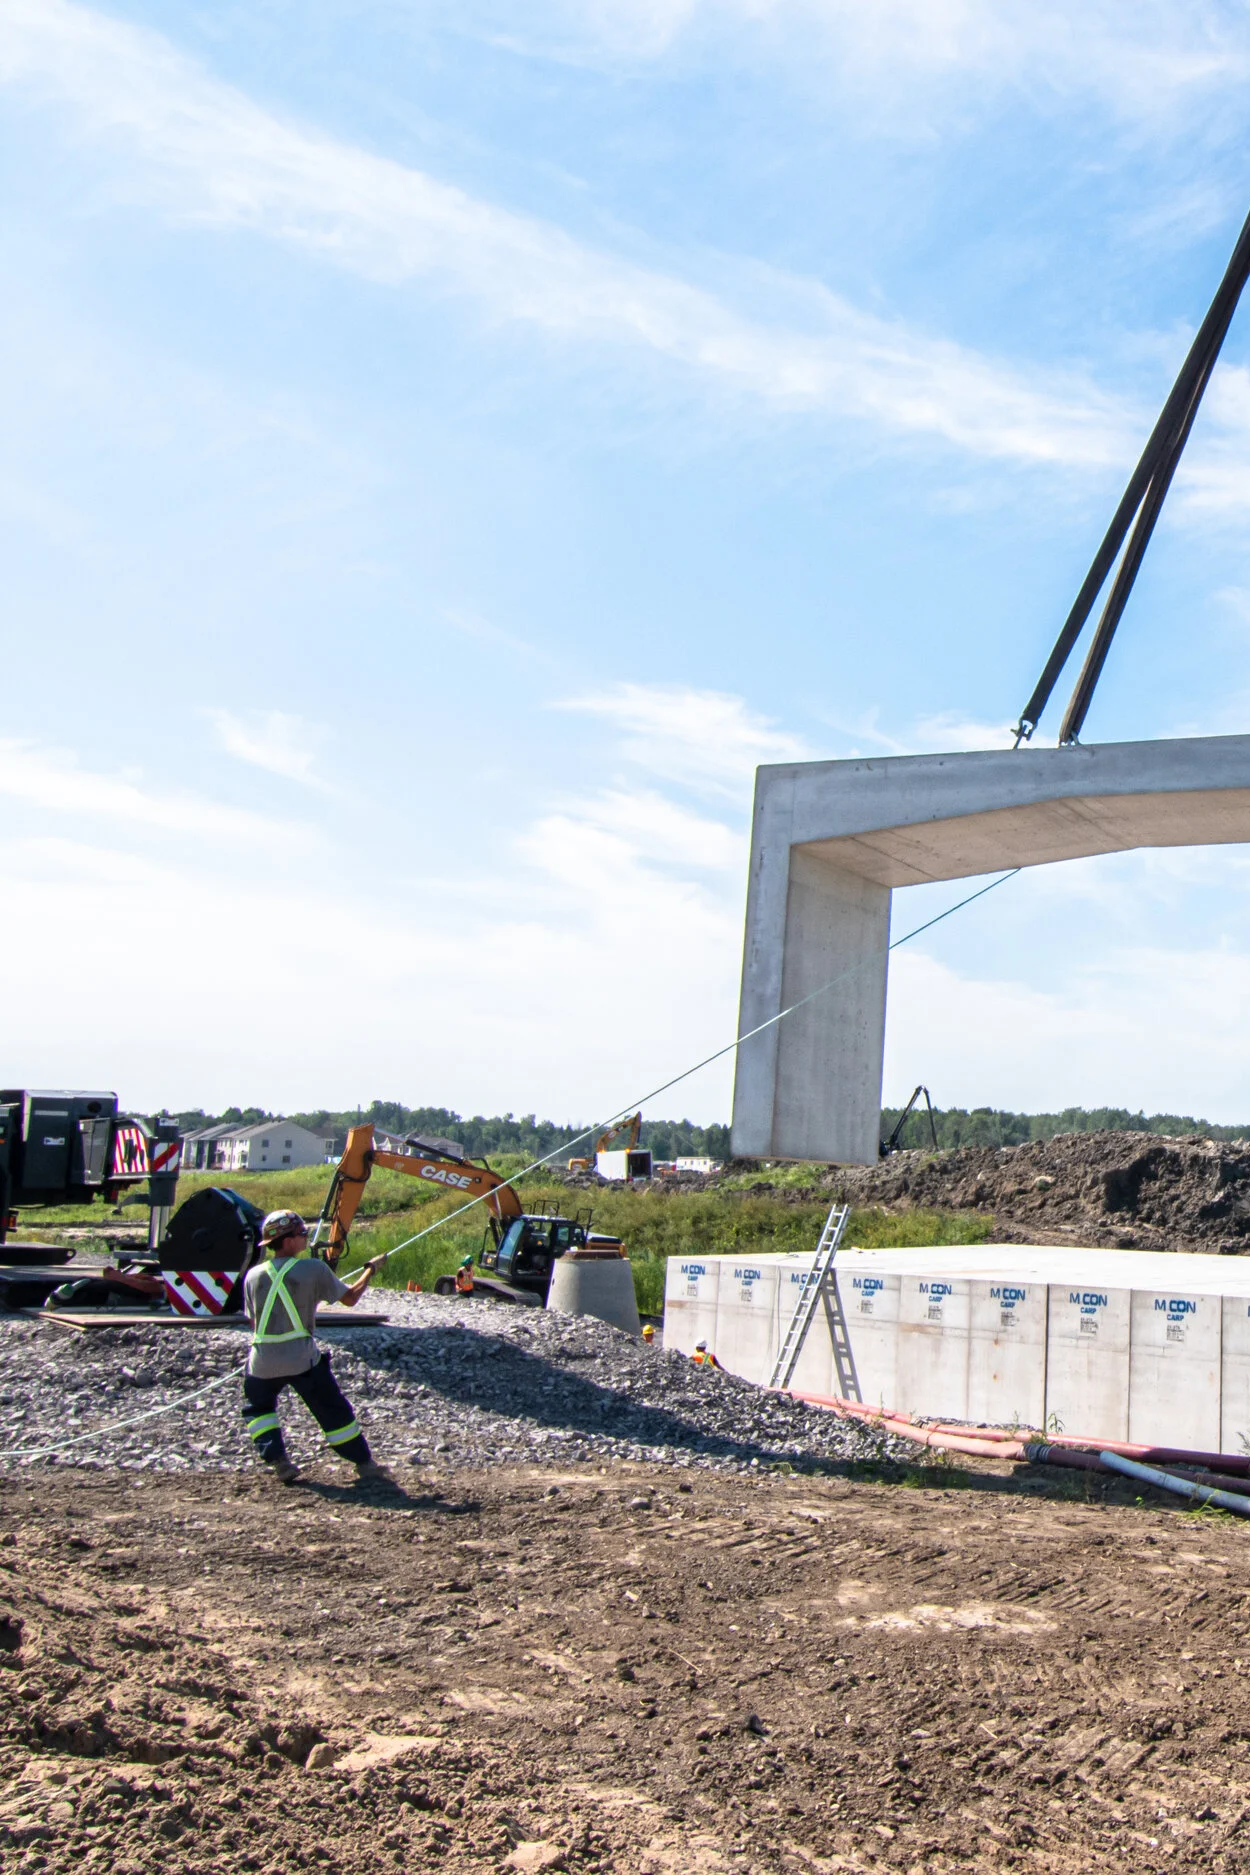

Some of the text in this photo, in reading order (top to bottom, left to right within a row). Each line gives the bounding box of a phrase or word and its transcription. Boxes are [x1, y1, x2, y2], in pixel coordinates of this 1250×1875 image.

[421, 1165, 472, 1189] CASE
[682, 1264, 705, 1275] M CON
[735, 1269, 761, 1280] M CON
[791, 1272, 820, 1285] M CN
[853, 1278, 883, 1290] M CON
[920, 1283, 952, 1296] M CON
[991, 1288, 1025, 1301] M CON
[1002, 1300, 1016, 1308] CARP
[1070, 1293, 1107, 1306] M CON
[1155, 1299, 1195, 1313] M CON
